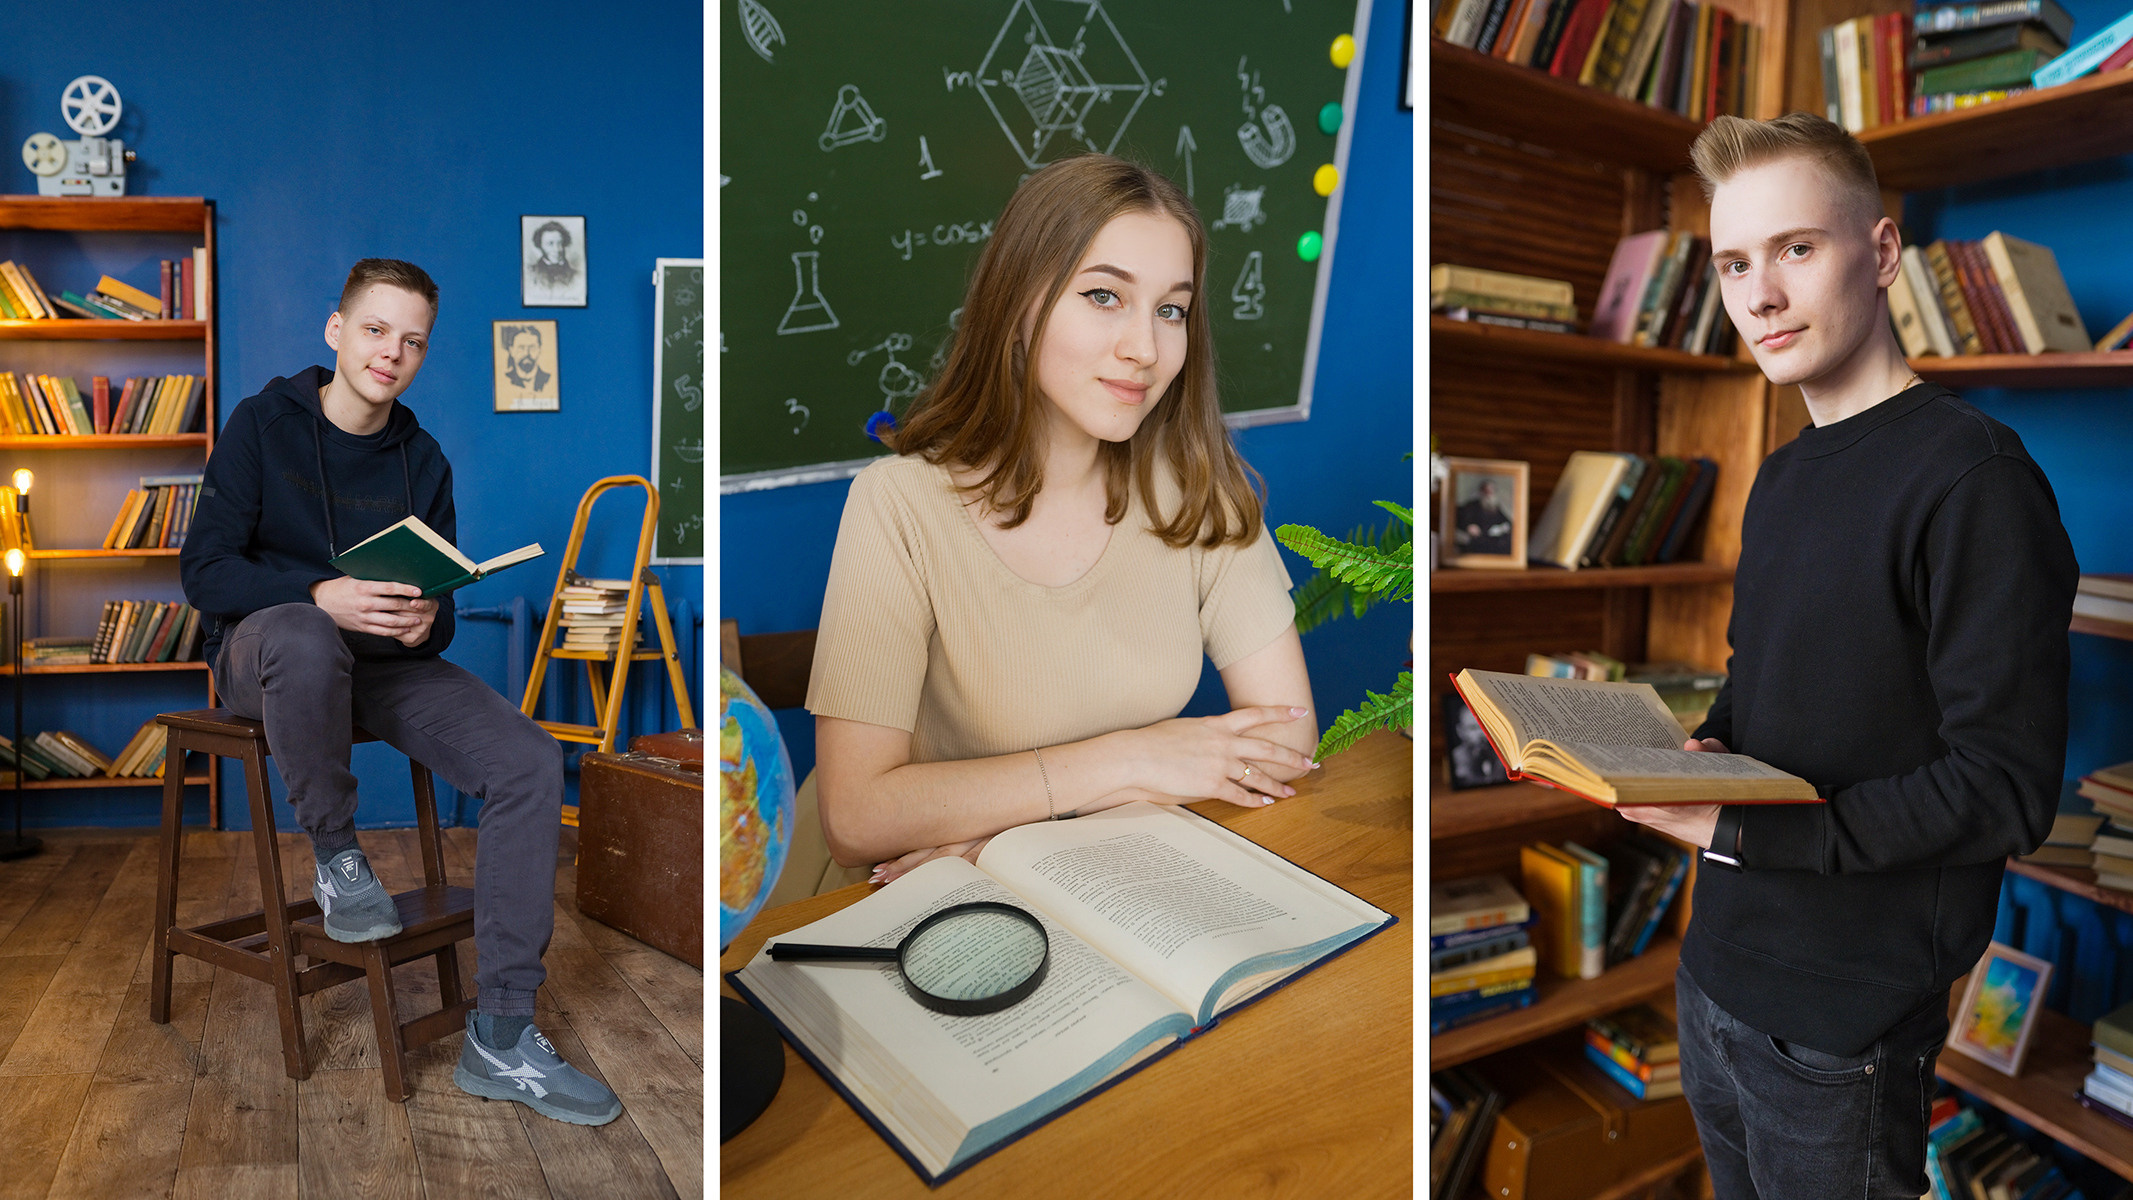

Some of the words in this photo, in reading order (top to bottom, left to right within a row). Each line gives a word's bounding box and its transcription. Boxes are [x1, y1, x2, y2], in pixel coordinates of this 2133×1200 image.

[943, 66, 973, 92] m
[918, 135, 943, 180] 1
[1231, 251, 1266, 320] 4
[674, 373, 702, 412] 5
